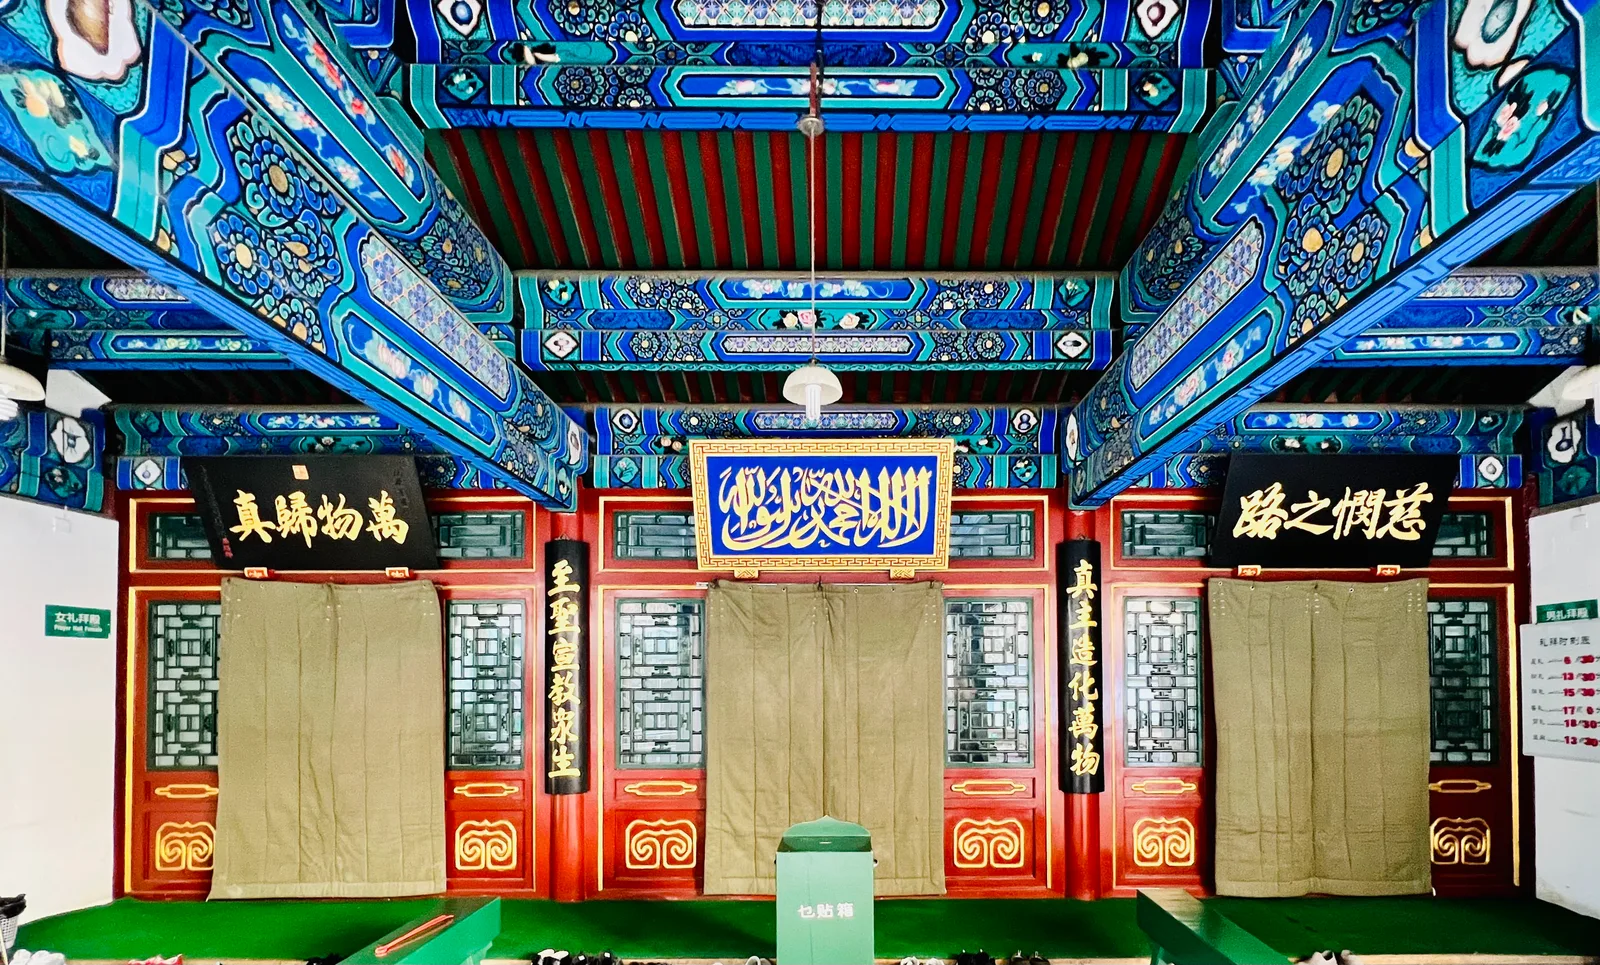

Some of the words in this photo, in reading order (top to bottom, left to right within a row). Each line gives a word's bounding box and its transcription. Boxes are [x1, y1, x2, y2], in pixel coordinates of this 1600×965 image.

[55, 612, 100, 624] 女礼拜殿
[797, 902, 854, 919] 乜贴箱
